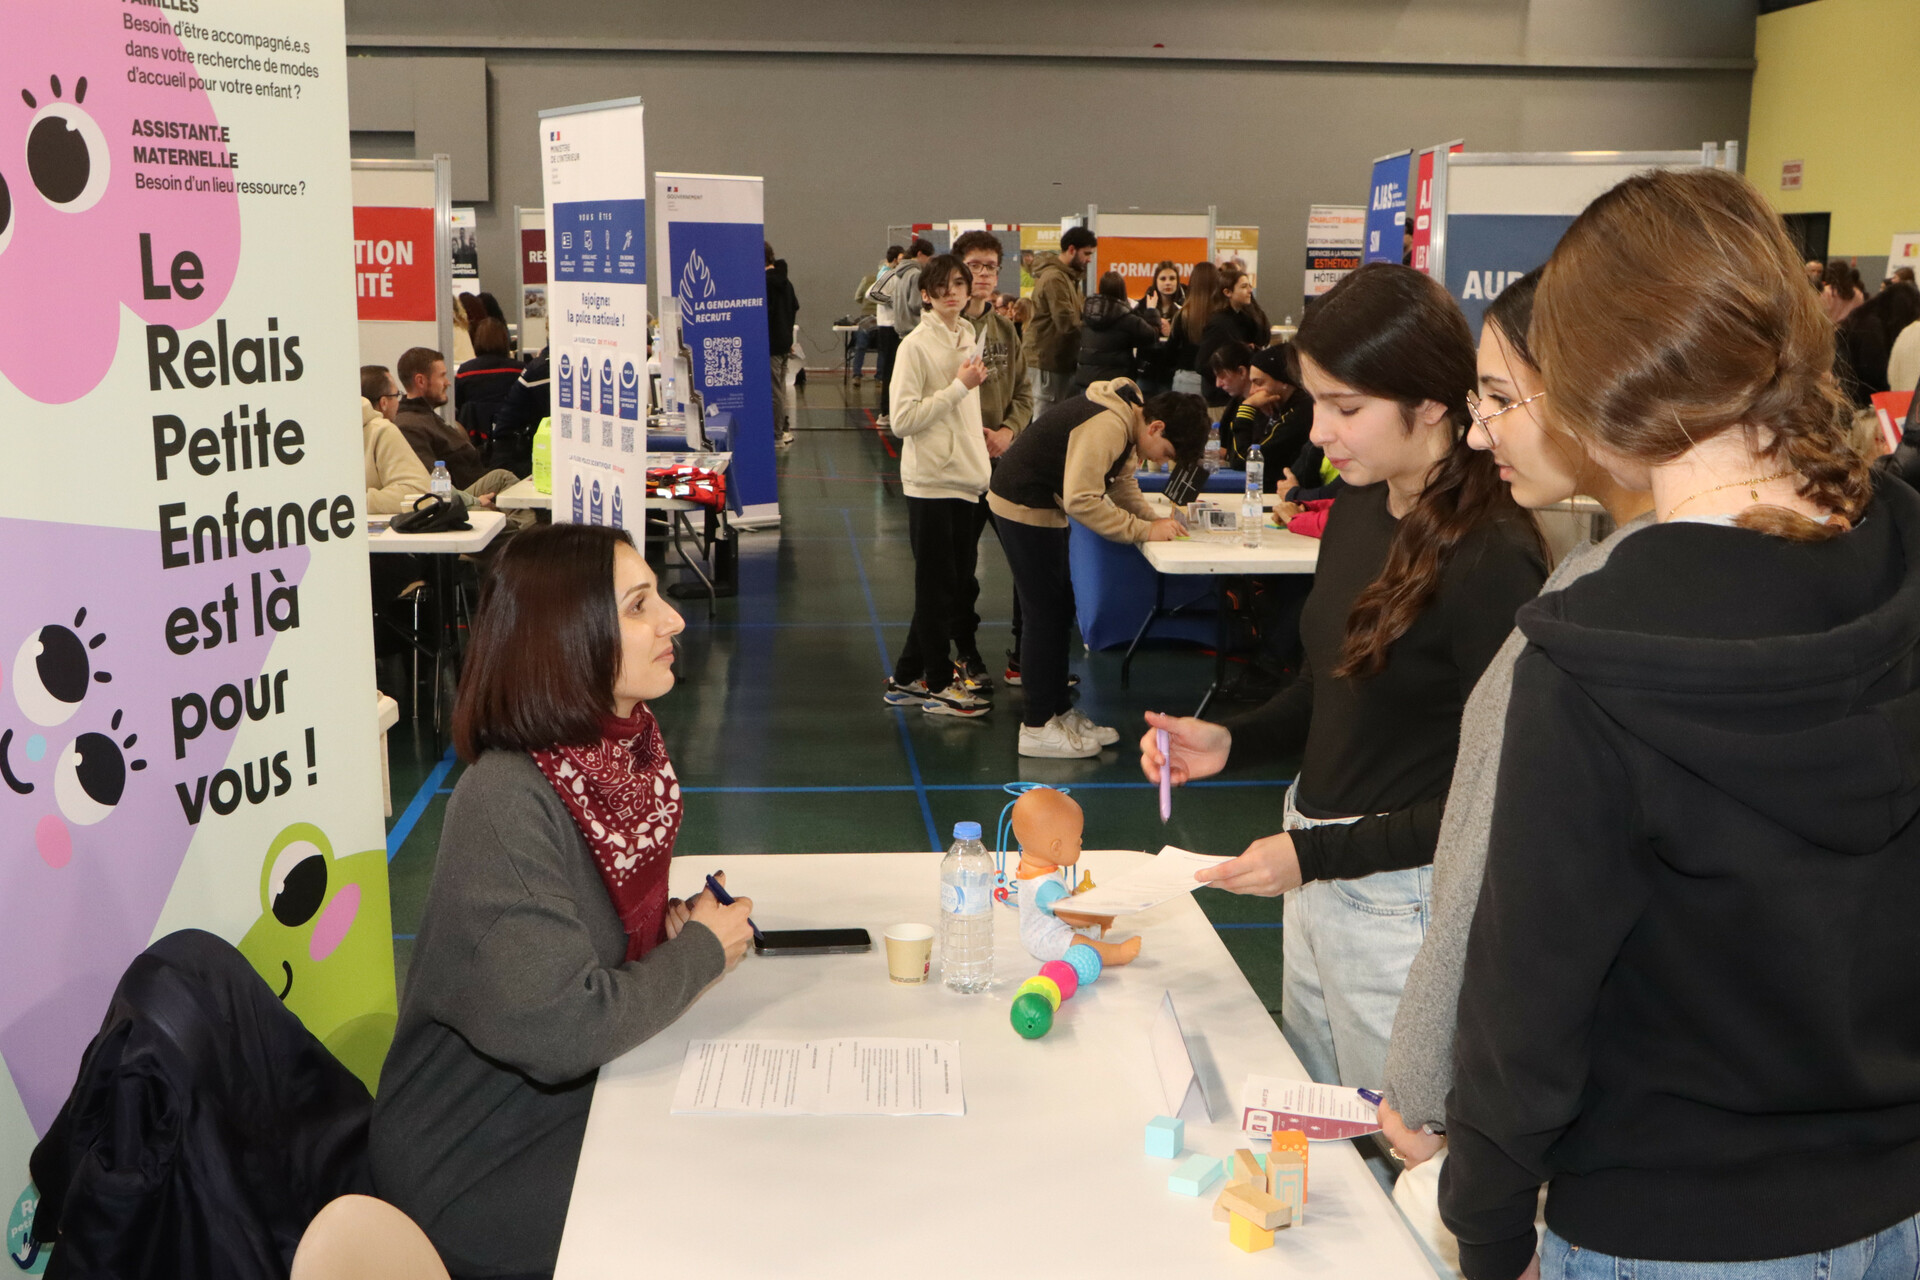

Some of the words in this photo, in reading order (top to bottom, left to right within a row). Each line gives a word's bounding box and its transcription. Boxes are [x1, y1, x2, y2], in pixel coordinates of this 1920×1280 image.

[122, 0, 199, 13] MILLES
[123, 13, 171, 36] Besoin
[173, 21, 209, 40] d'être
[211, 29, 310, 54] accompagné.e.s
[125, 40, 159, 59] dans
[161, 47, 195, 63] votre
[197, 51, 261, 71] recherche
[263, 57, 278, 73] de
[280, 62, 319, 78] modes
[127, 66, 186, 88] d'accueil
[189, 76, 217, 92] pour
[219, 79, 253, 95] votre
[255, 82, 292, 99] enfant
[132, 119, 231, 143] ASSISTANT.E
[133, 146, 239, 169] MATERNEL.LE
[135, 172, 182, 190] Besoin
[184, 175, 211, 192] d'un
[212, 176, 234, 193] lieu
[236, 181, 297, 195] ressource
[139, 233, 205, 300] Le
[353, 240, 413, 265] TION
[358, 267, 394, 298] ITÉ
[1110, 263, 1194, 277] FORMAON
[567, 309, 574, 323] la
[575, 310, 591, 327] police
[592, 312, 620, 327] nationale
[694, 302, 705, 311] LA
[707, 298, 763, 310] GENDARMERIE
[695, 312, 731, 323] RECRUTE
[146, 317, 304, 391] Relais
[152, 404, 305, 481] Petite
[158, 491, 355, 570] Enfance
[165, 582, 239, 656] est
[251, 568, 300, 637] là
[171, 668, 289, 760] pour
[175, 750, 292, 826] vous
